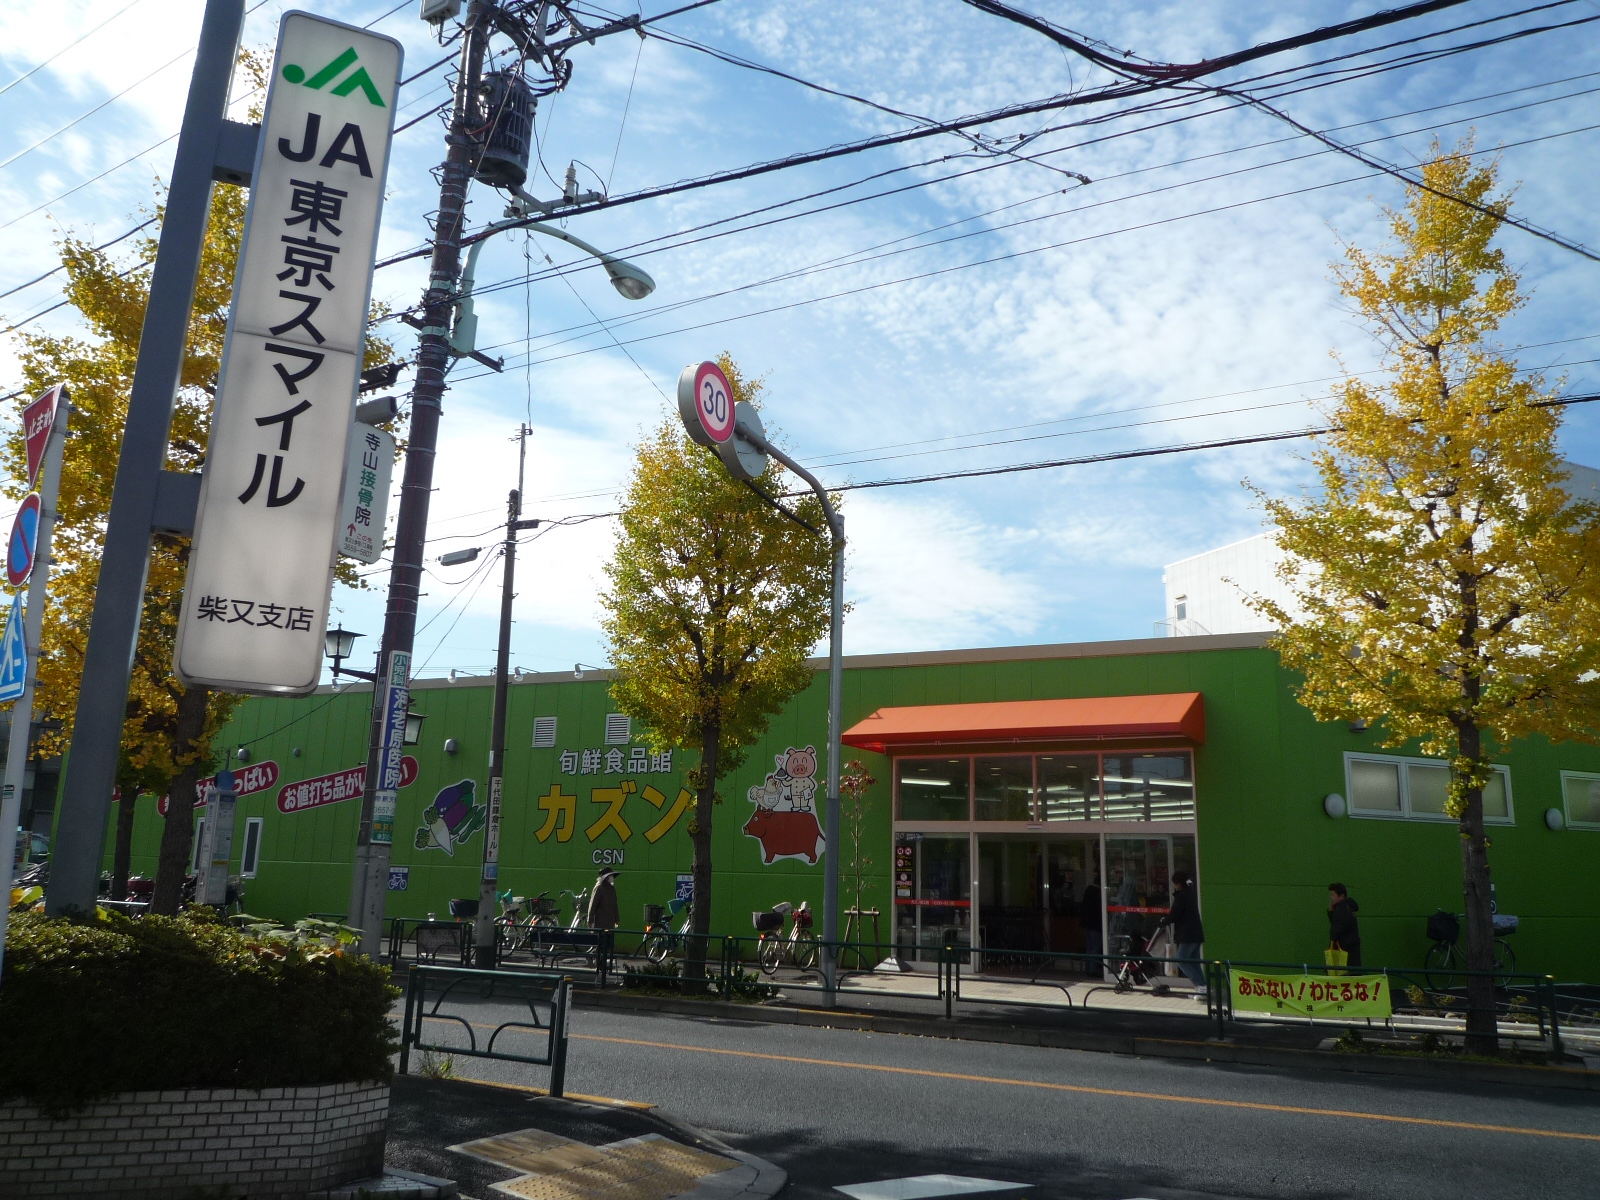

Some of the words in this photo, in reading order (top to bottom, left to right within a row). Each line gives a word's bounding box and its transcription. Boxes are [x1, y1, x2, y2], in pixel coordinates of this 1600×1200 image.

[277, 112, 374, 179] JA
[237, 178, 349, 508] 東京スマイル
[703, 381, 726, 423] 30
[27, 407, 52, 440] 止まれ
[354, 432, 380, 527] 寺山接骨院
[197, 594, 315, 633] 柴又支店
[392, 655, 407, 688] 小児科
[383, 688, 408, 790] 海老原医院
[558, 747, 673, 775] 旬鮮食品館
[534, 780, 693, 845] カズン
[592, 849, 624, 864] CSN
[1238, 976, 1381, 1002] あぶない！わたるな！
[1276, 1001, 1344, 1013] 警視庁
